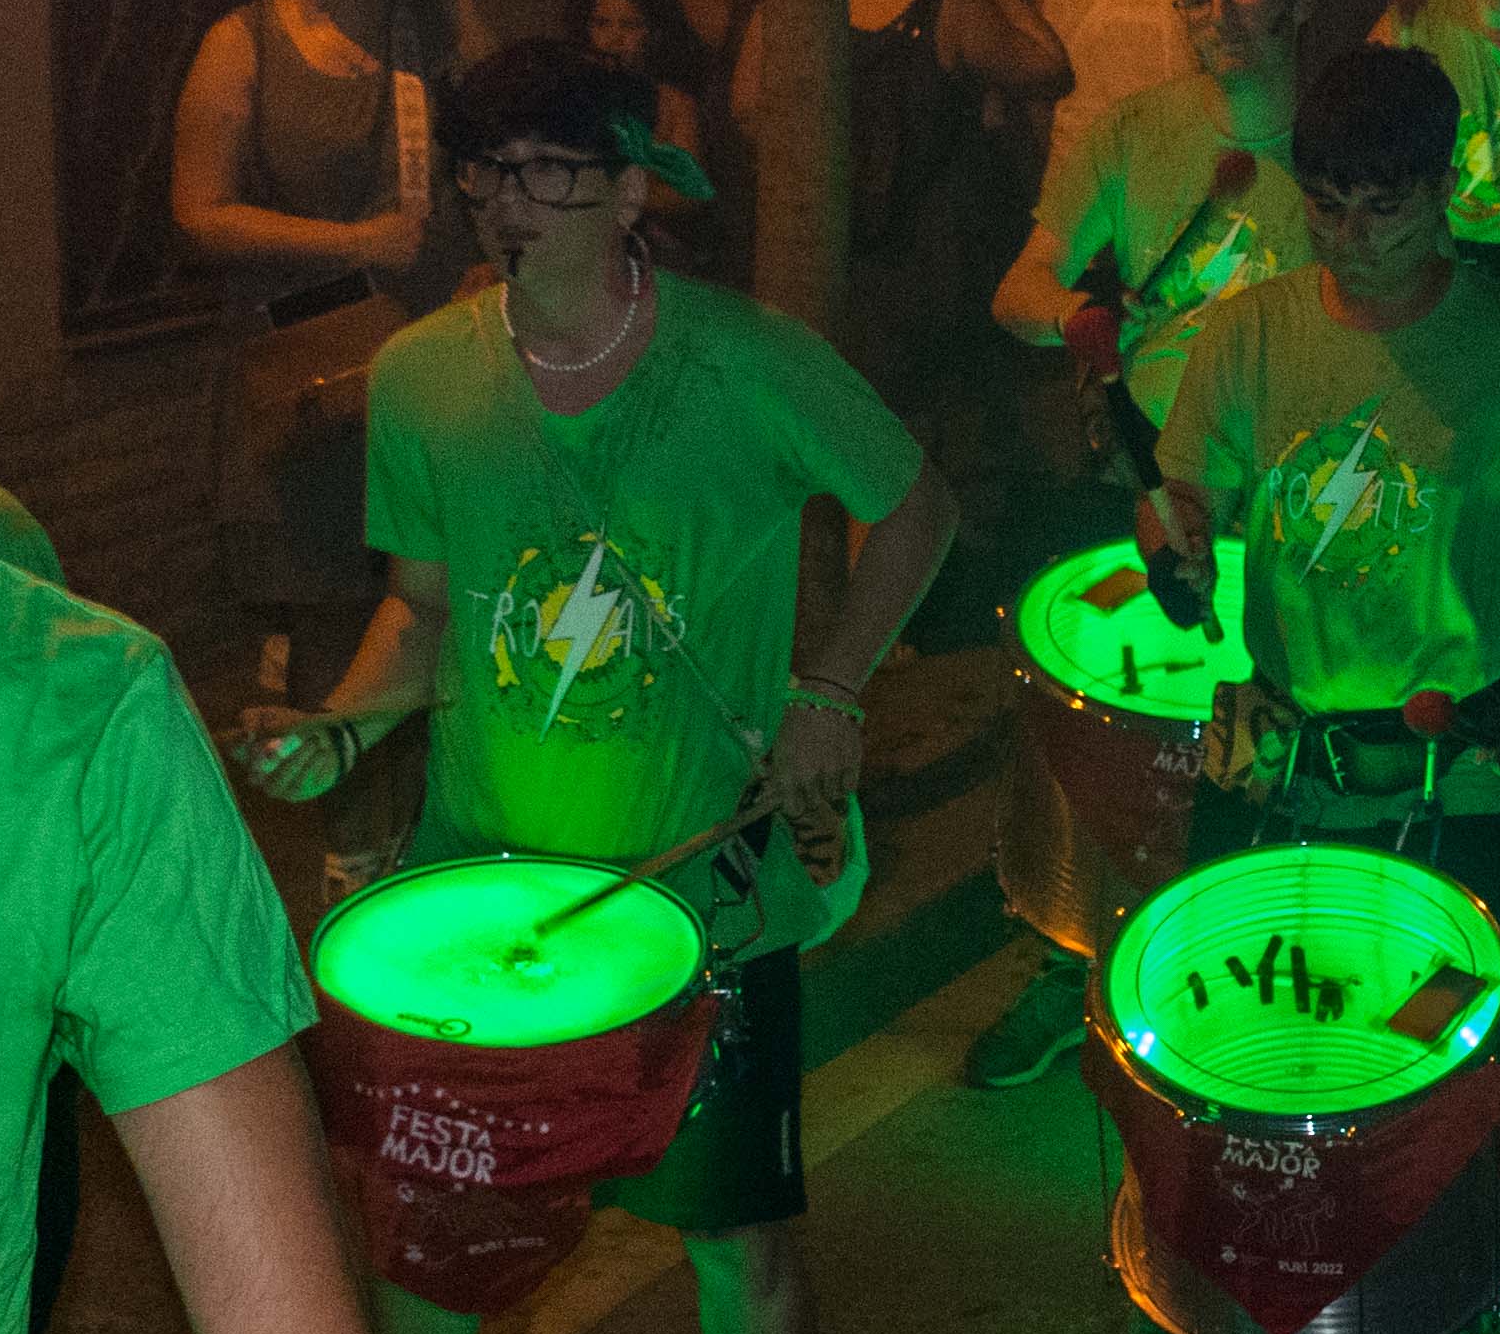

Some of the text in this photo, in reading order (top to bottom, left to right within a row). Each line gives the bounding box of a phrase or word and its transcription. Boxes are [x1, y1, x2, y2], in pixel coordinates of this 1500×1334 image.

[391, 1105, 492, 1151] FESTA
[382, 1133, 497, 1184] MAJOR
[1221, 1147, 1321, 1179] MAJOR
